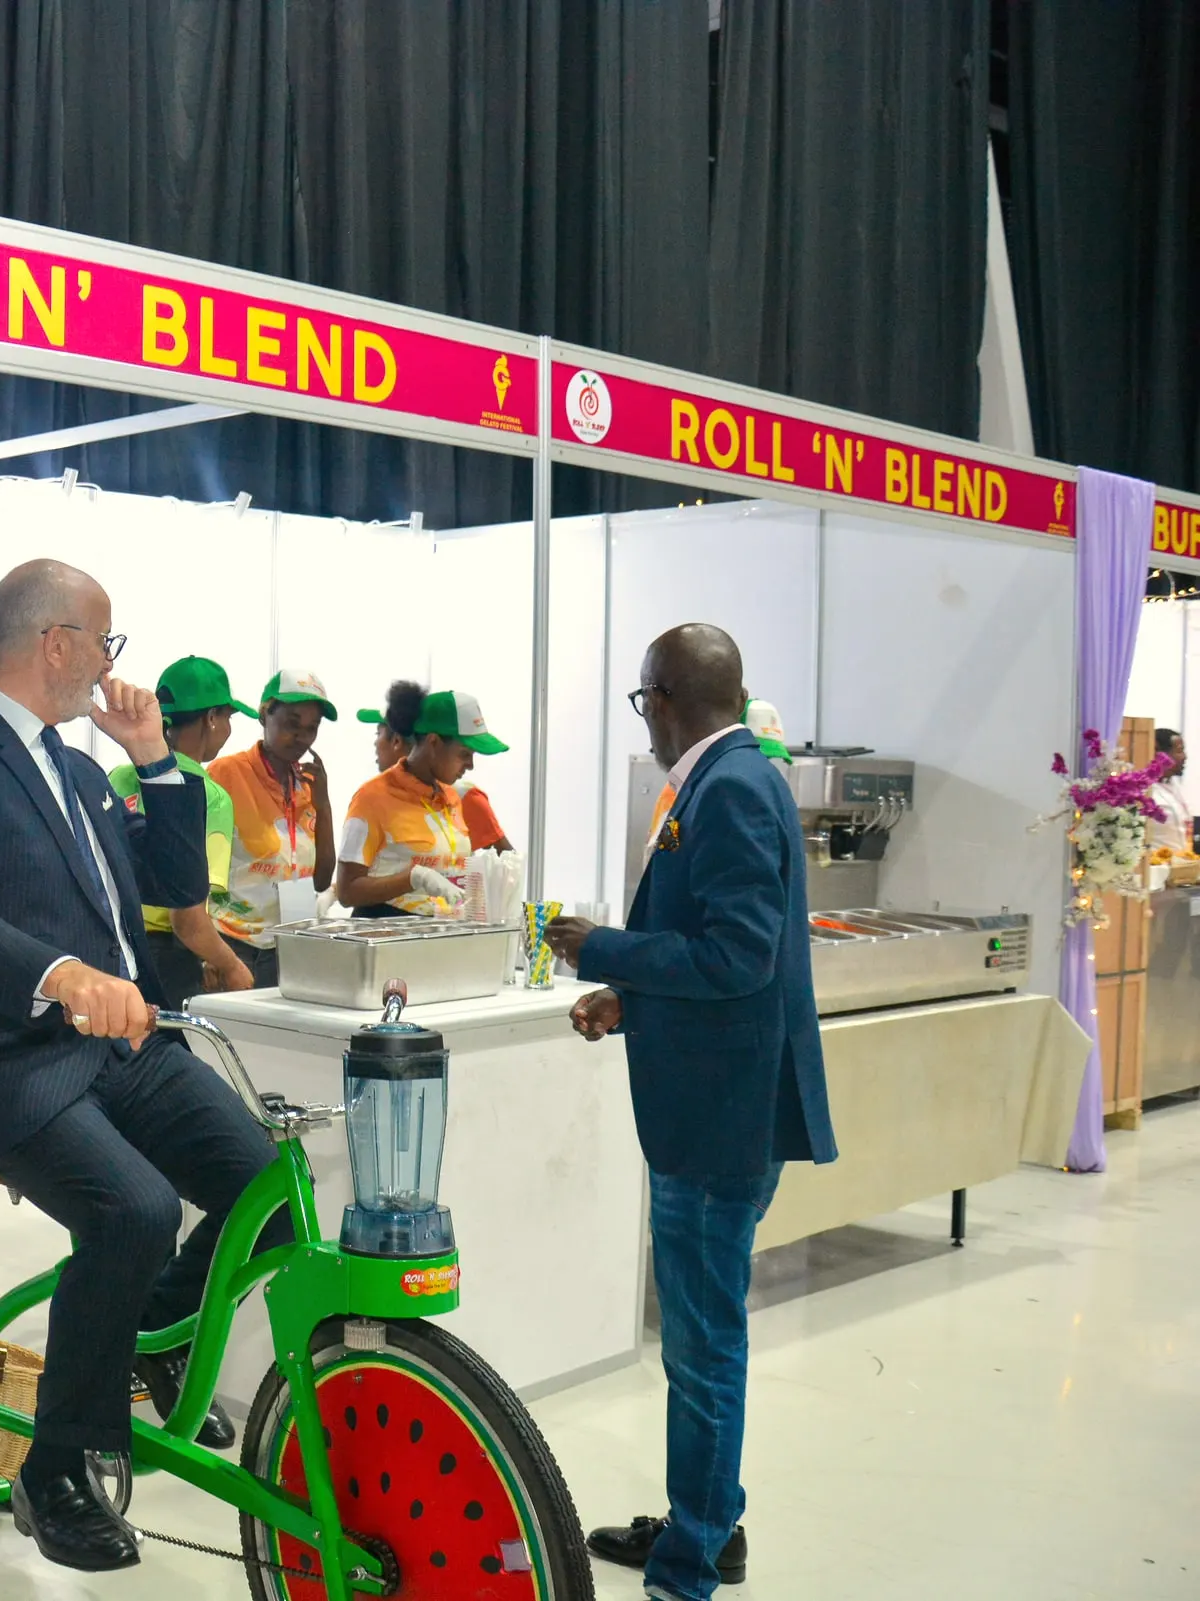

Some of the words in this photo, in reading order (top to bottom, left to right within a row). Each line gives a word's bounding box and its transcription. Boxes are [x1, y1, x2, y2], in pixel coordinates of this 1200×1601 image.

[142, 284, 397, 403] BLEND
[671, 398, 795, 482] ROLL
[885, 447, 1007, 521] BLEND
[404, 1273, 425, 1284] ROLL
